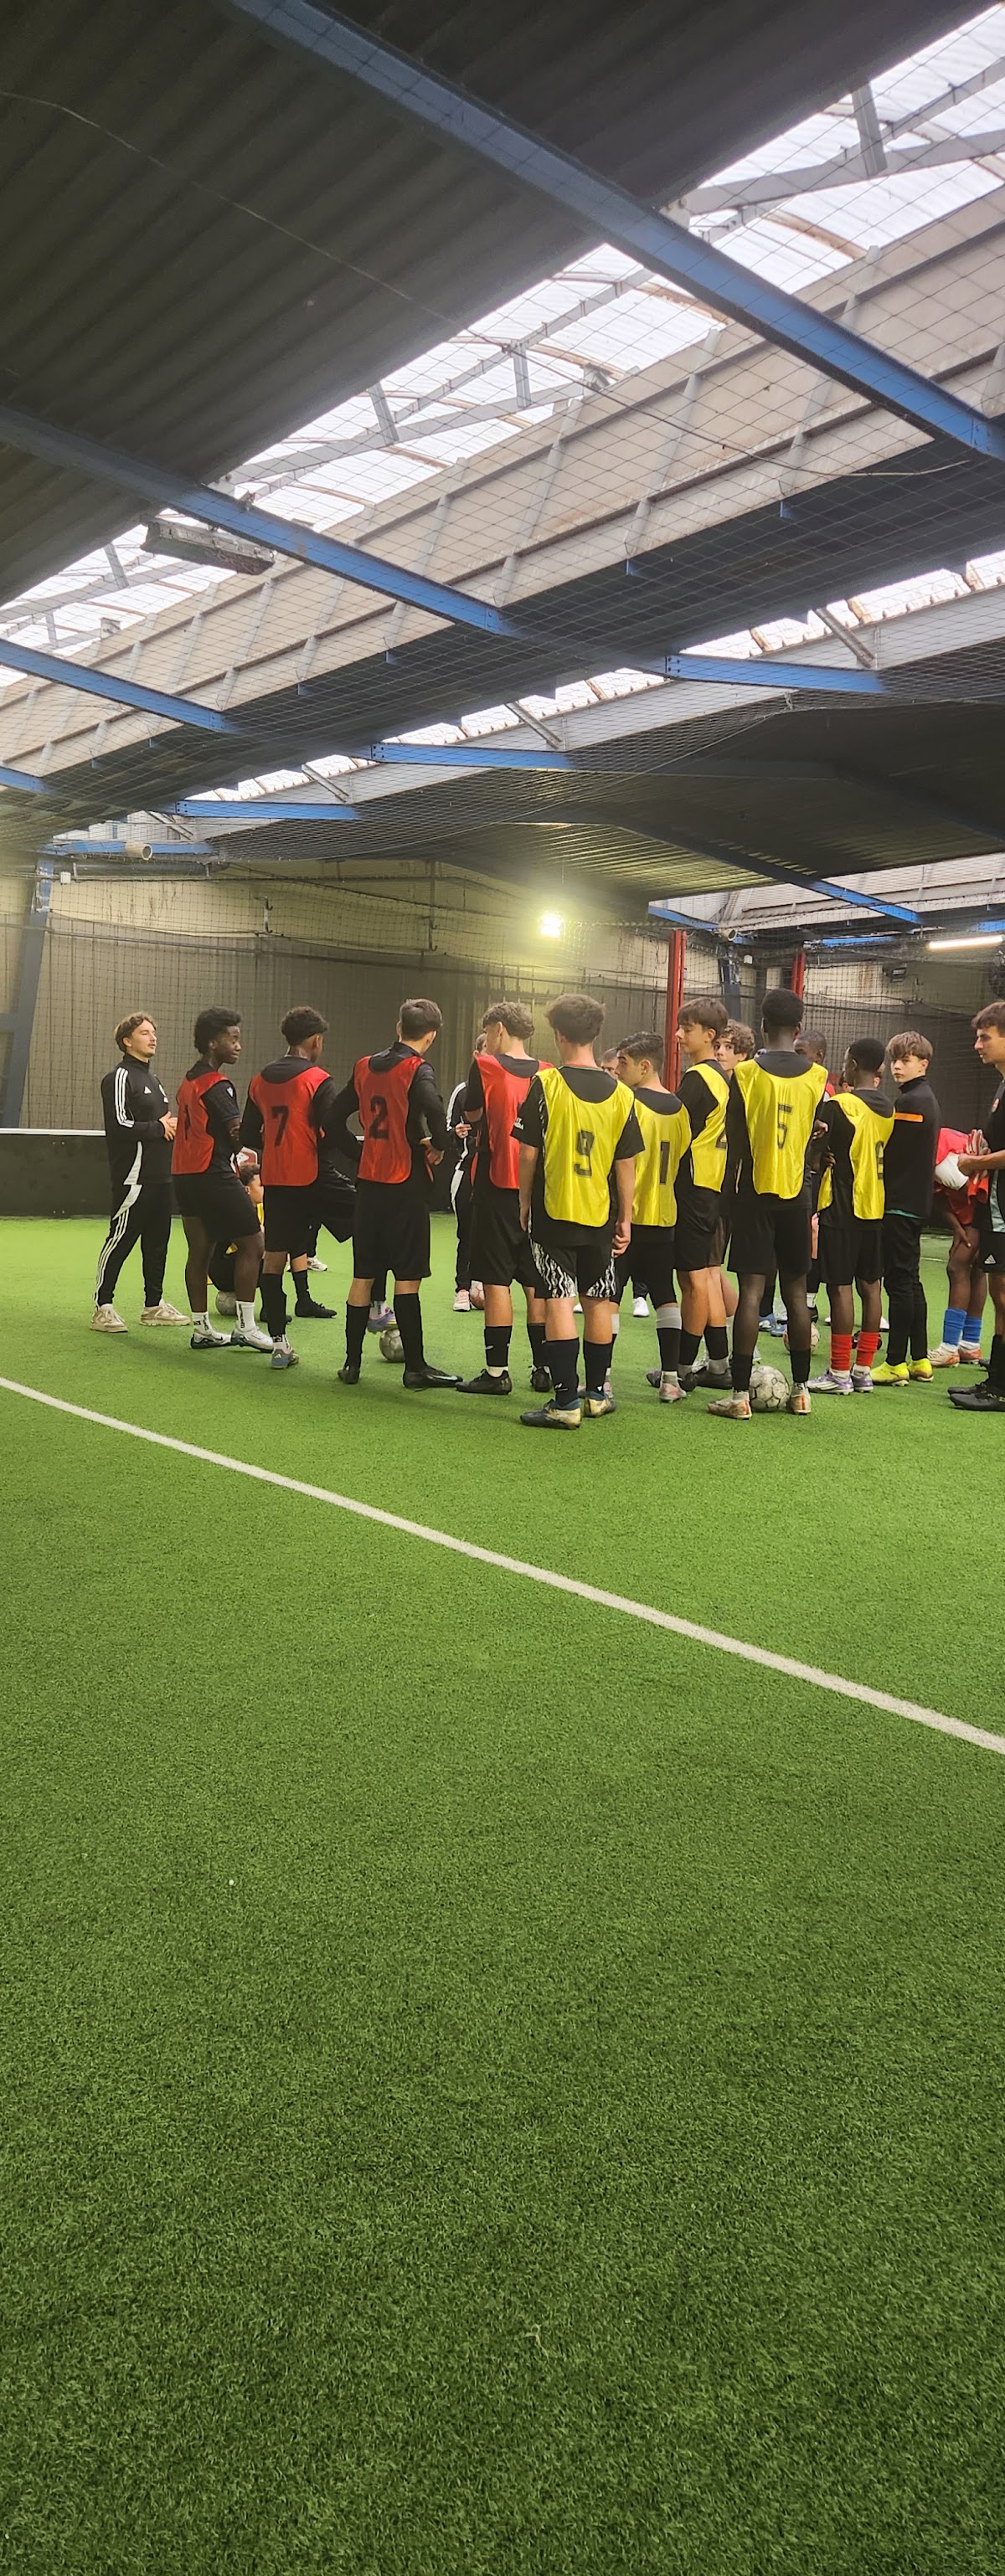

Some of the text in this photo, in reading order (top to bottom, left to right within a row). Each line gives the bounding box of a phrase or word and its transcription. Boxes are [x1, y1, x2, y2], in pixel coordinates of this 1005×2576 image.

[272, 1105, 289, 1146] 7
[369, 1095, 389, 1139] 2
[777, 1103, 793, 1149] 5
[574, 1130, 595, 1176] 9
[660, 1141, 670, 1184] 1
